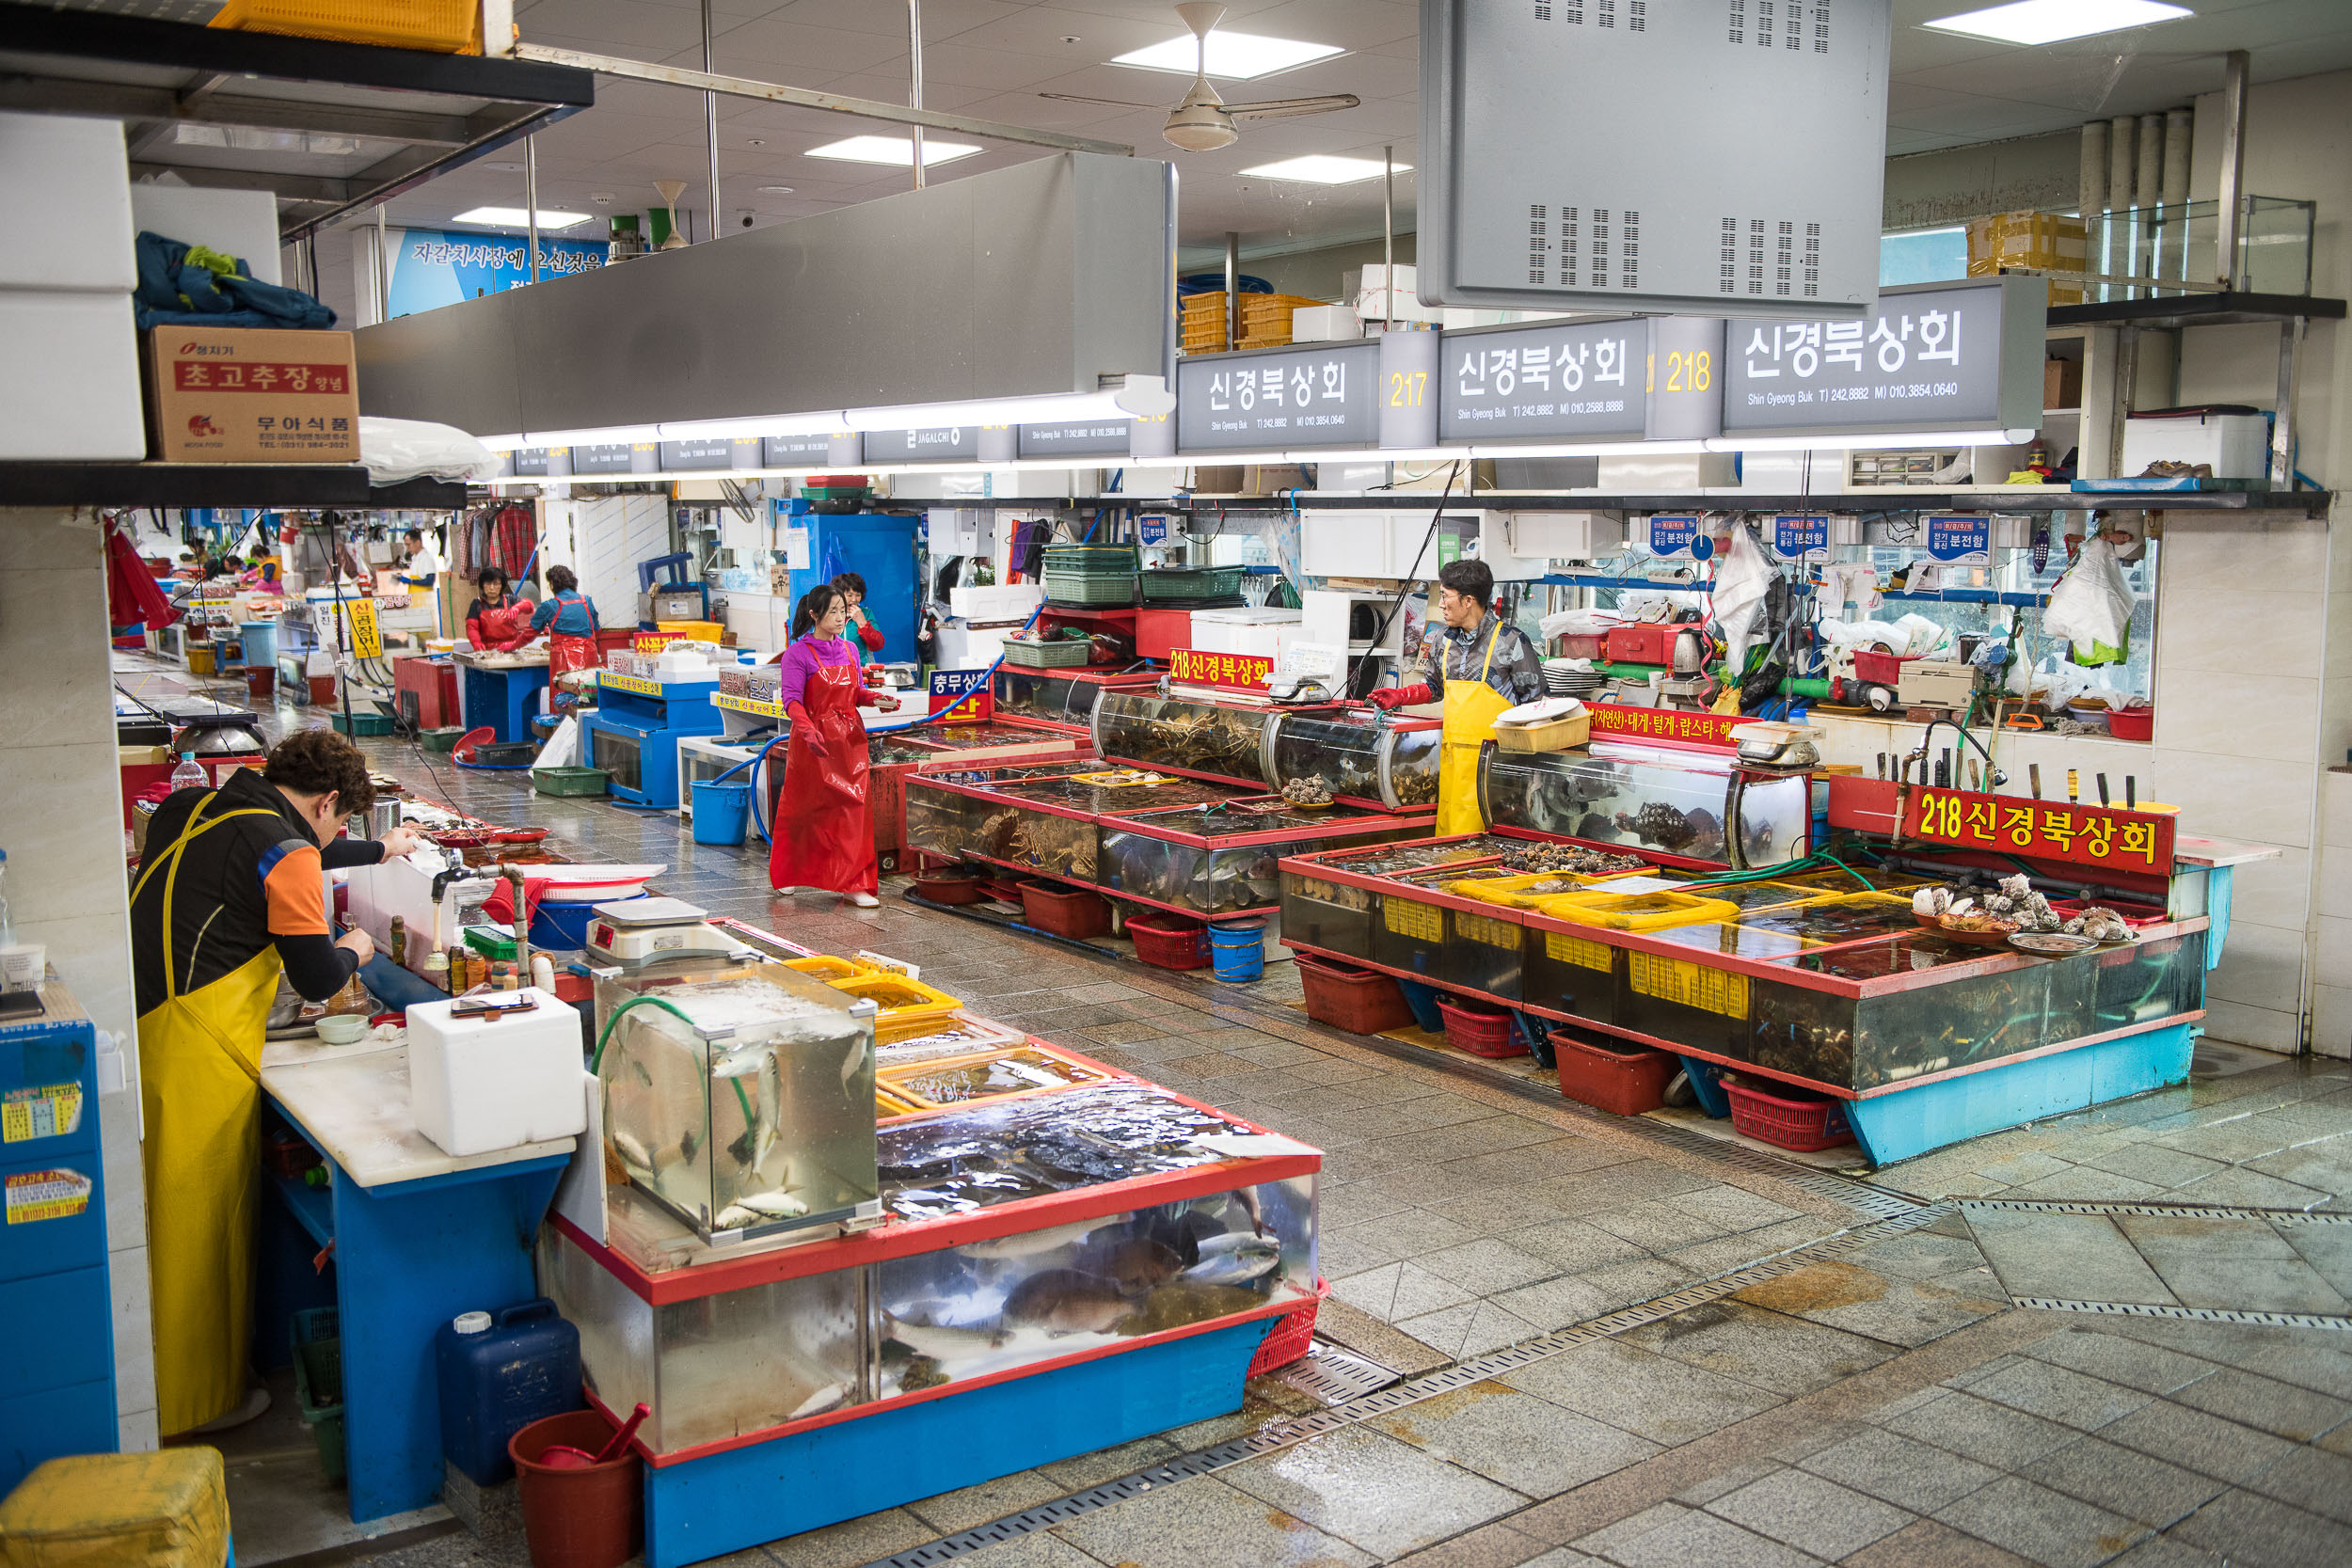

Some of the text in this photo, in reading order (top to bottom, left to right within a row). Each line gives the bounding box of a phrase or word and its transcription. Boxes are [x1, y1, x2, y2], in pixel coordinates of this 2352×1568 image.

[413, 243, 525, 270] 자갈치시장에
[1745, 309, 1961, 378] 신경북상회
[183, 364, 342, 391] 초고추장 양념
[1458, 338, 1626, 396] 신경북상회
[1666, 350, 1710, 392] 218
[1210, 361, 1345, 411] 신경북상회
[1390, 372, 1427, 406] 217
[1748, 393, 1764, 405] Shin
[1767, 391, 1795, 406] Gyeong
[1798, 390, 1813, 403] Buk
[1820, 388, 1828, 403] T)
[1875, 386, 1887, 400] M)
[258, 417, 349, 432] 무아식품
[1458, 408, 1470, 420] Shin
[1472, 407, 1493, 420] Gyeong
[1495, 406, 1505, 418] Buk
[1211, 420, 1221, 431] Shin
[1222, 420, 1238, 432] Gyeong
[1239, 420, 1248, 430] Buk
[918, 432, 949, 444] JAGALCHI
[1667, 532, 1693, 544] 분전함
[1950, 534, 1983, 547] 분전함
